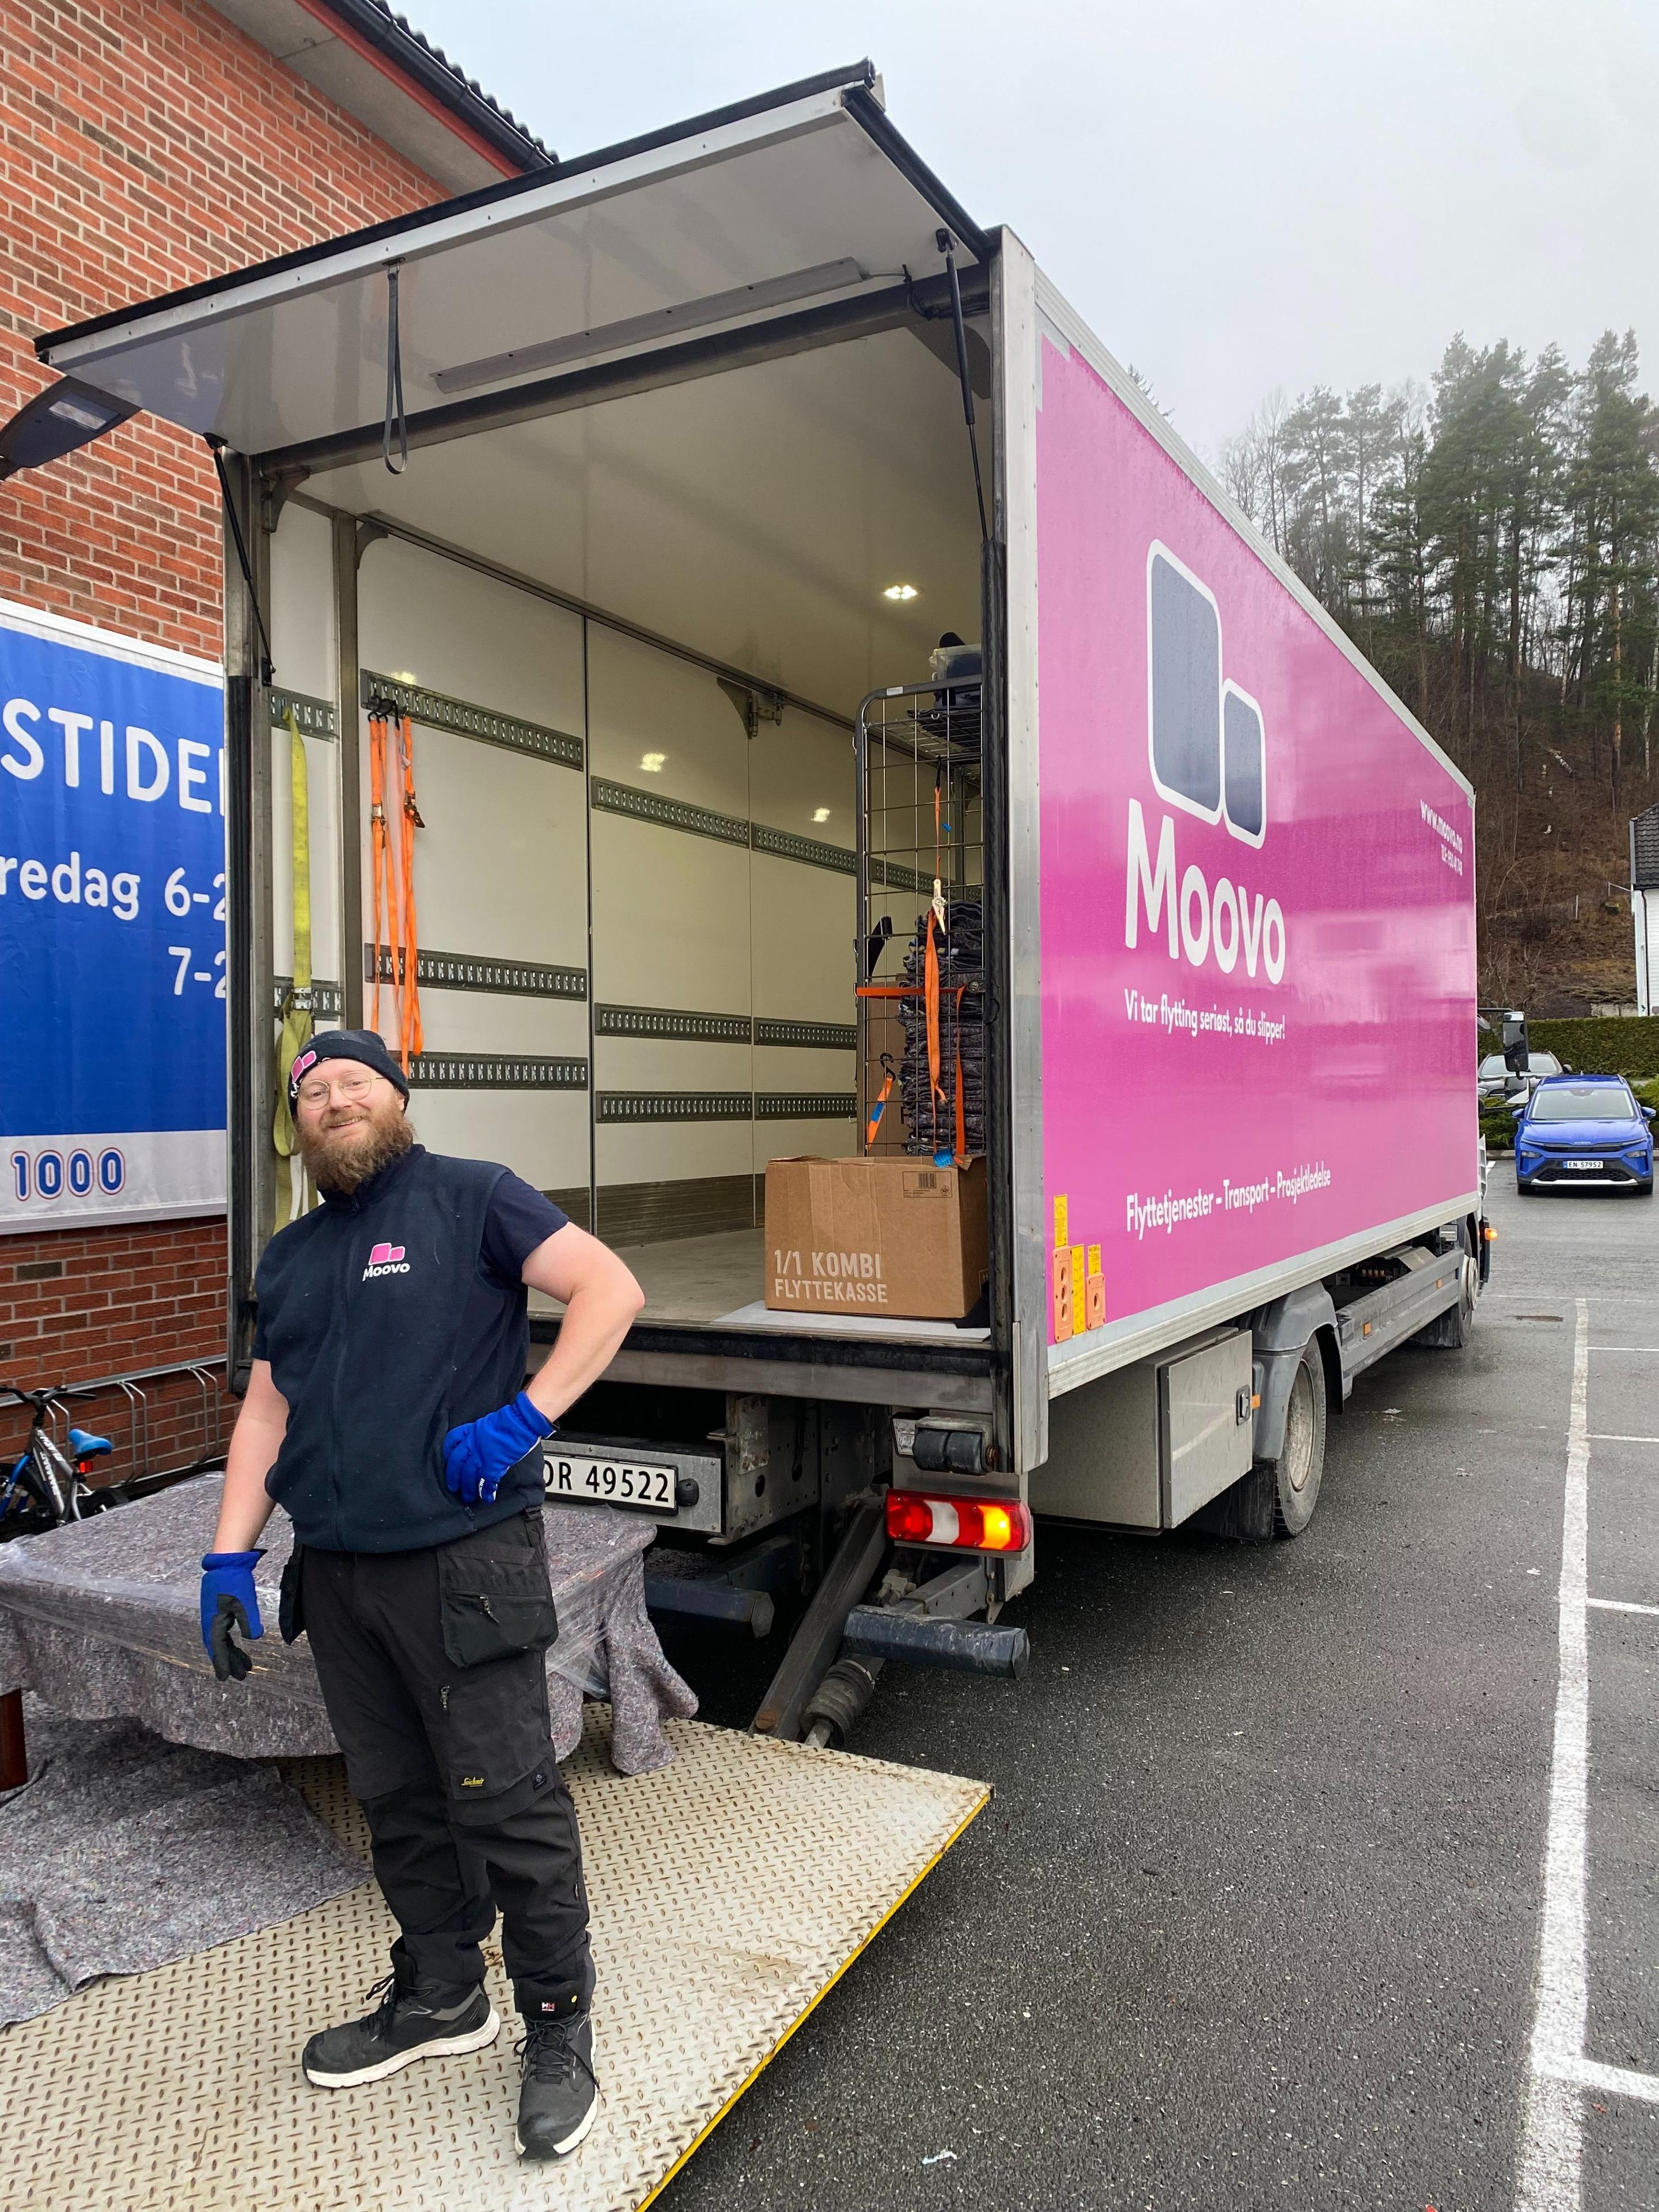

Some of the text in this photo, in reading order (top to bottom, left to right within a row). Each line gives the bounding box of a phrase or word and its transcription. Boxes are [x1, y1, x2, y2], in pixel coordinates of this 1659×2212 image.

[1, 698, 225, 817] STIDE
[1420, 799, 1463, 854] www.moovo.no
[1124, 988, 1286, 1045] Vi tar flytting seriøst, så du slipper!
[10, 1147, 126, 1202] 1000
[1126, 1188, 1214, 1241] Flyttetjenester
[1223, 1176, 1269, 1214] Transport
[1277, 1161, 1331, 1205] Prosjektledelse
[774, 1249, 881, 1279] 1/1 KOMBI
[774, 1278, 889, 1303] FLYTTEKASSE
[585, 1465, 669, 1503] 49522
